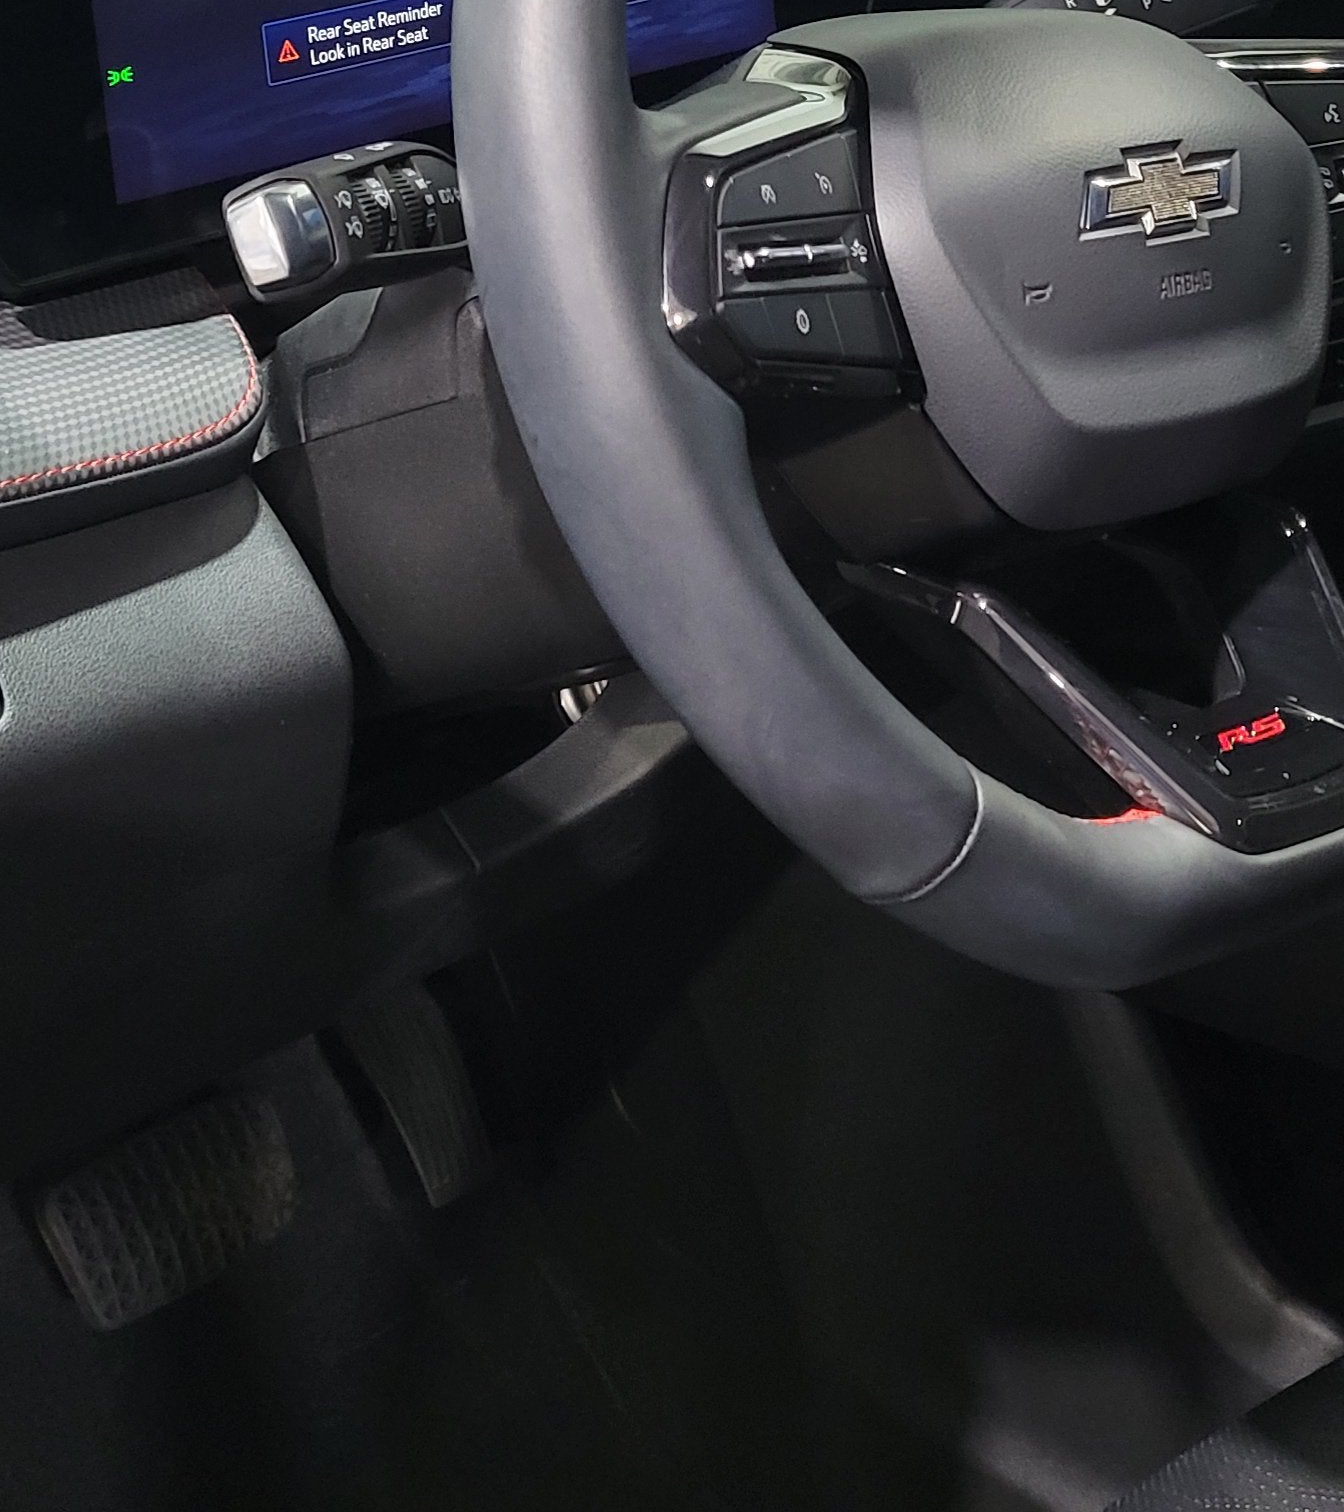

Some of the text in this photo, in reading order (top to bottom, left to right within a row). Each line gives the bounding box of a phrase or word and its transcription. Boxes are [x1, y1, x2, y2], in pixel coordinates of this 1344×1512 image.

[307, 1, 443, 44] Rear Seat Reminder
[309, 26, 429, 66] Look in Rear Seat
[1159, 269, 1213, 300] AIRBAG
[1217, 710, 1287, 752] RS
